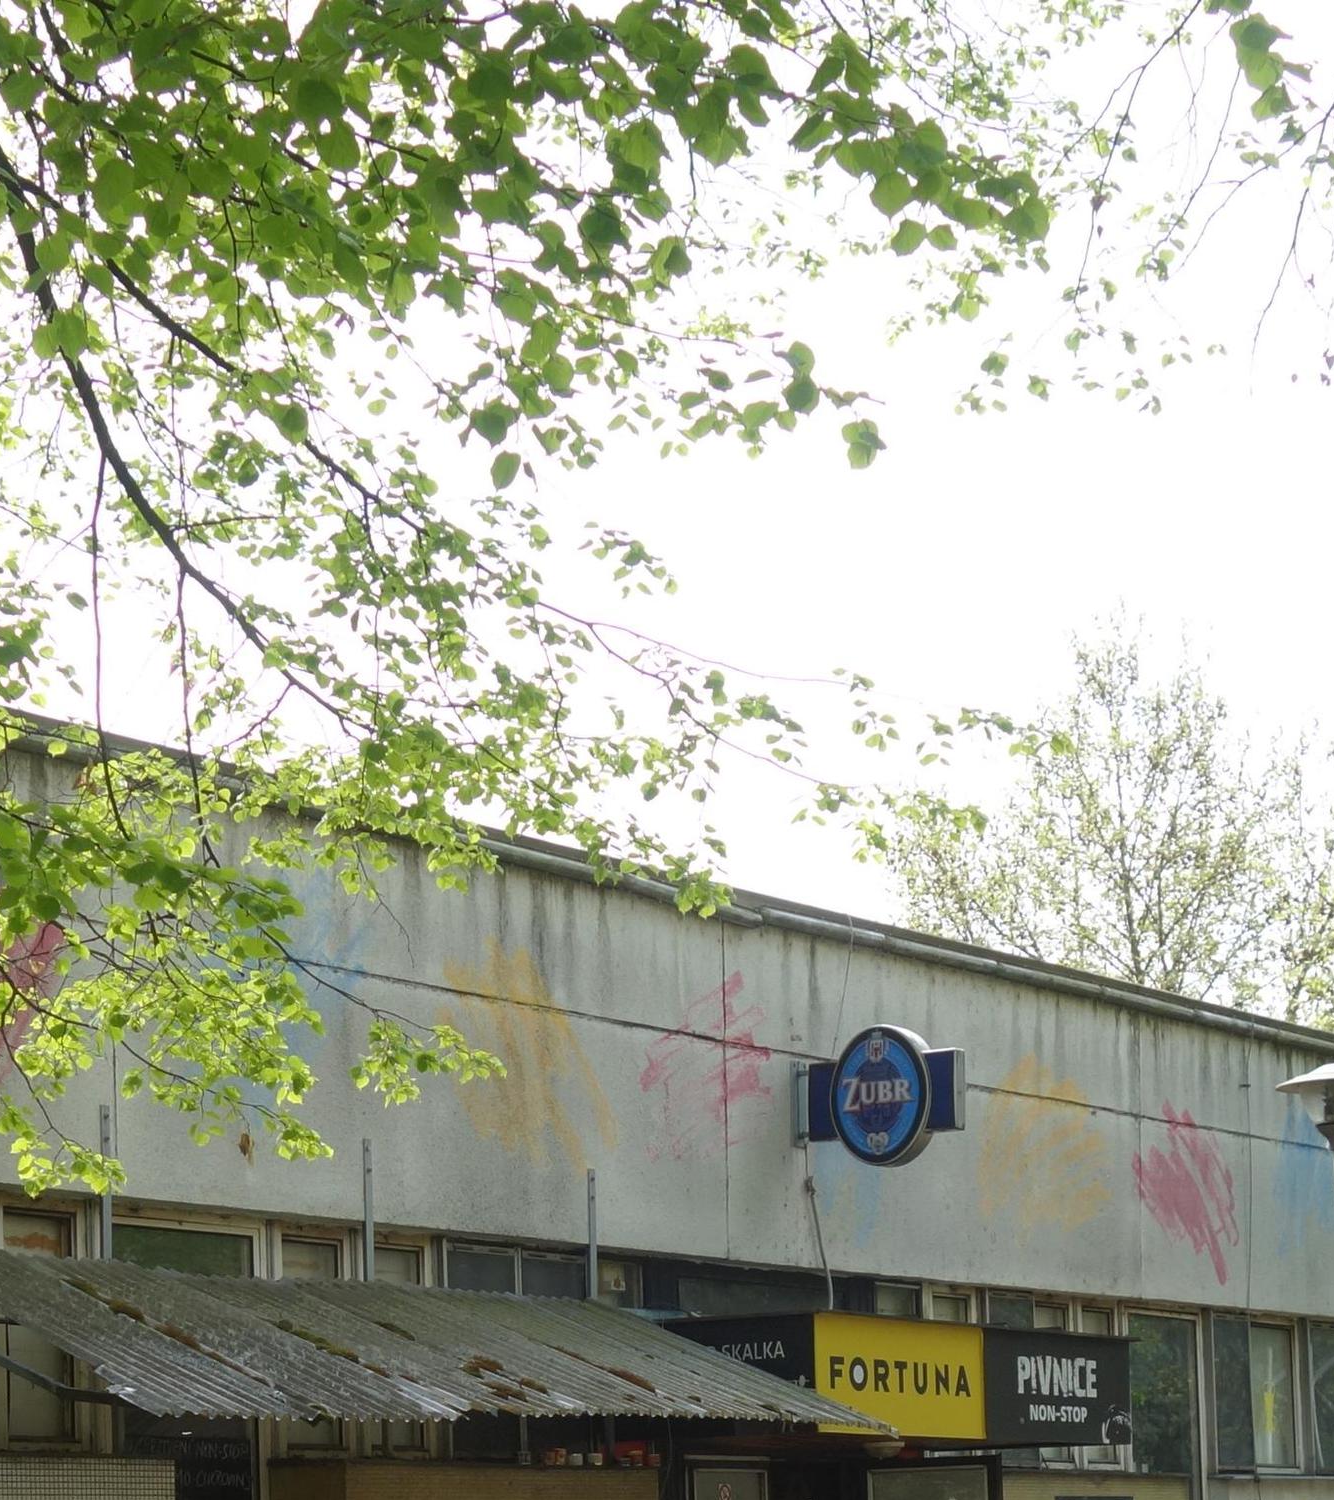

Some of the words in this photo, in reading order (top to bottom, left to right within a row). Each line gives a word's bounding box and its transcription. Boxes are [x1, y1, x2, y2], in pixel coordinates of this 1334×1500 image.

[842, 1075, 914, 1112] ZUBR
[721, 1340, 785, 1360] SKALKA
[830, 1356, 971, 1397] FORTUNA
[1018, 1356, 1097, 1398] PIVNICE
[1029, 1404, 1088, 1423] NON-STOP
